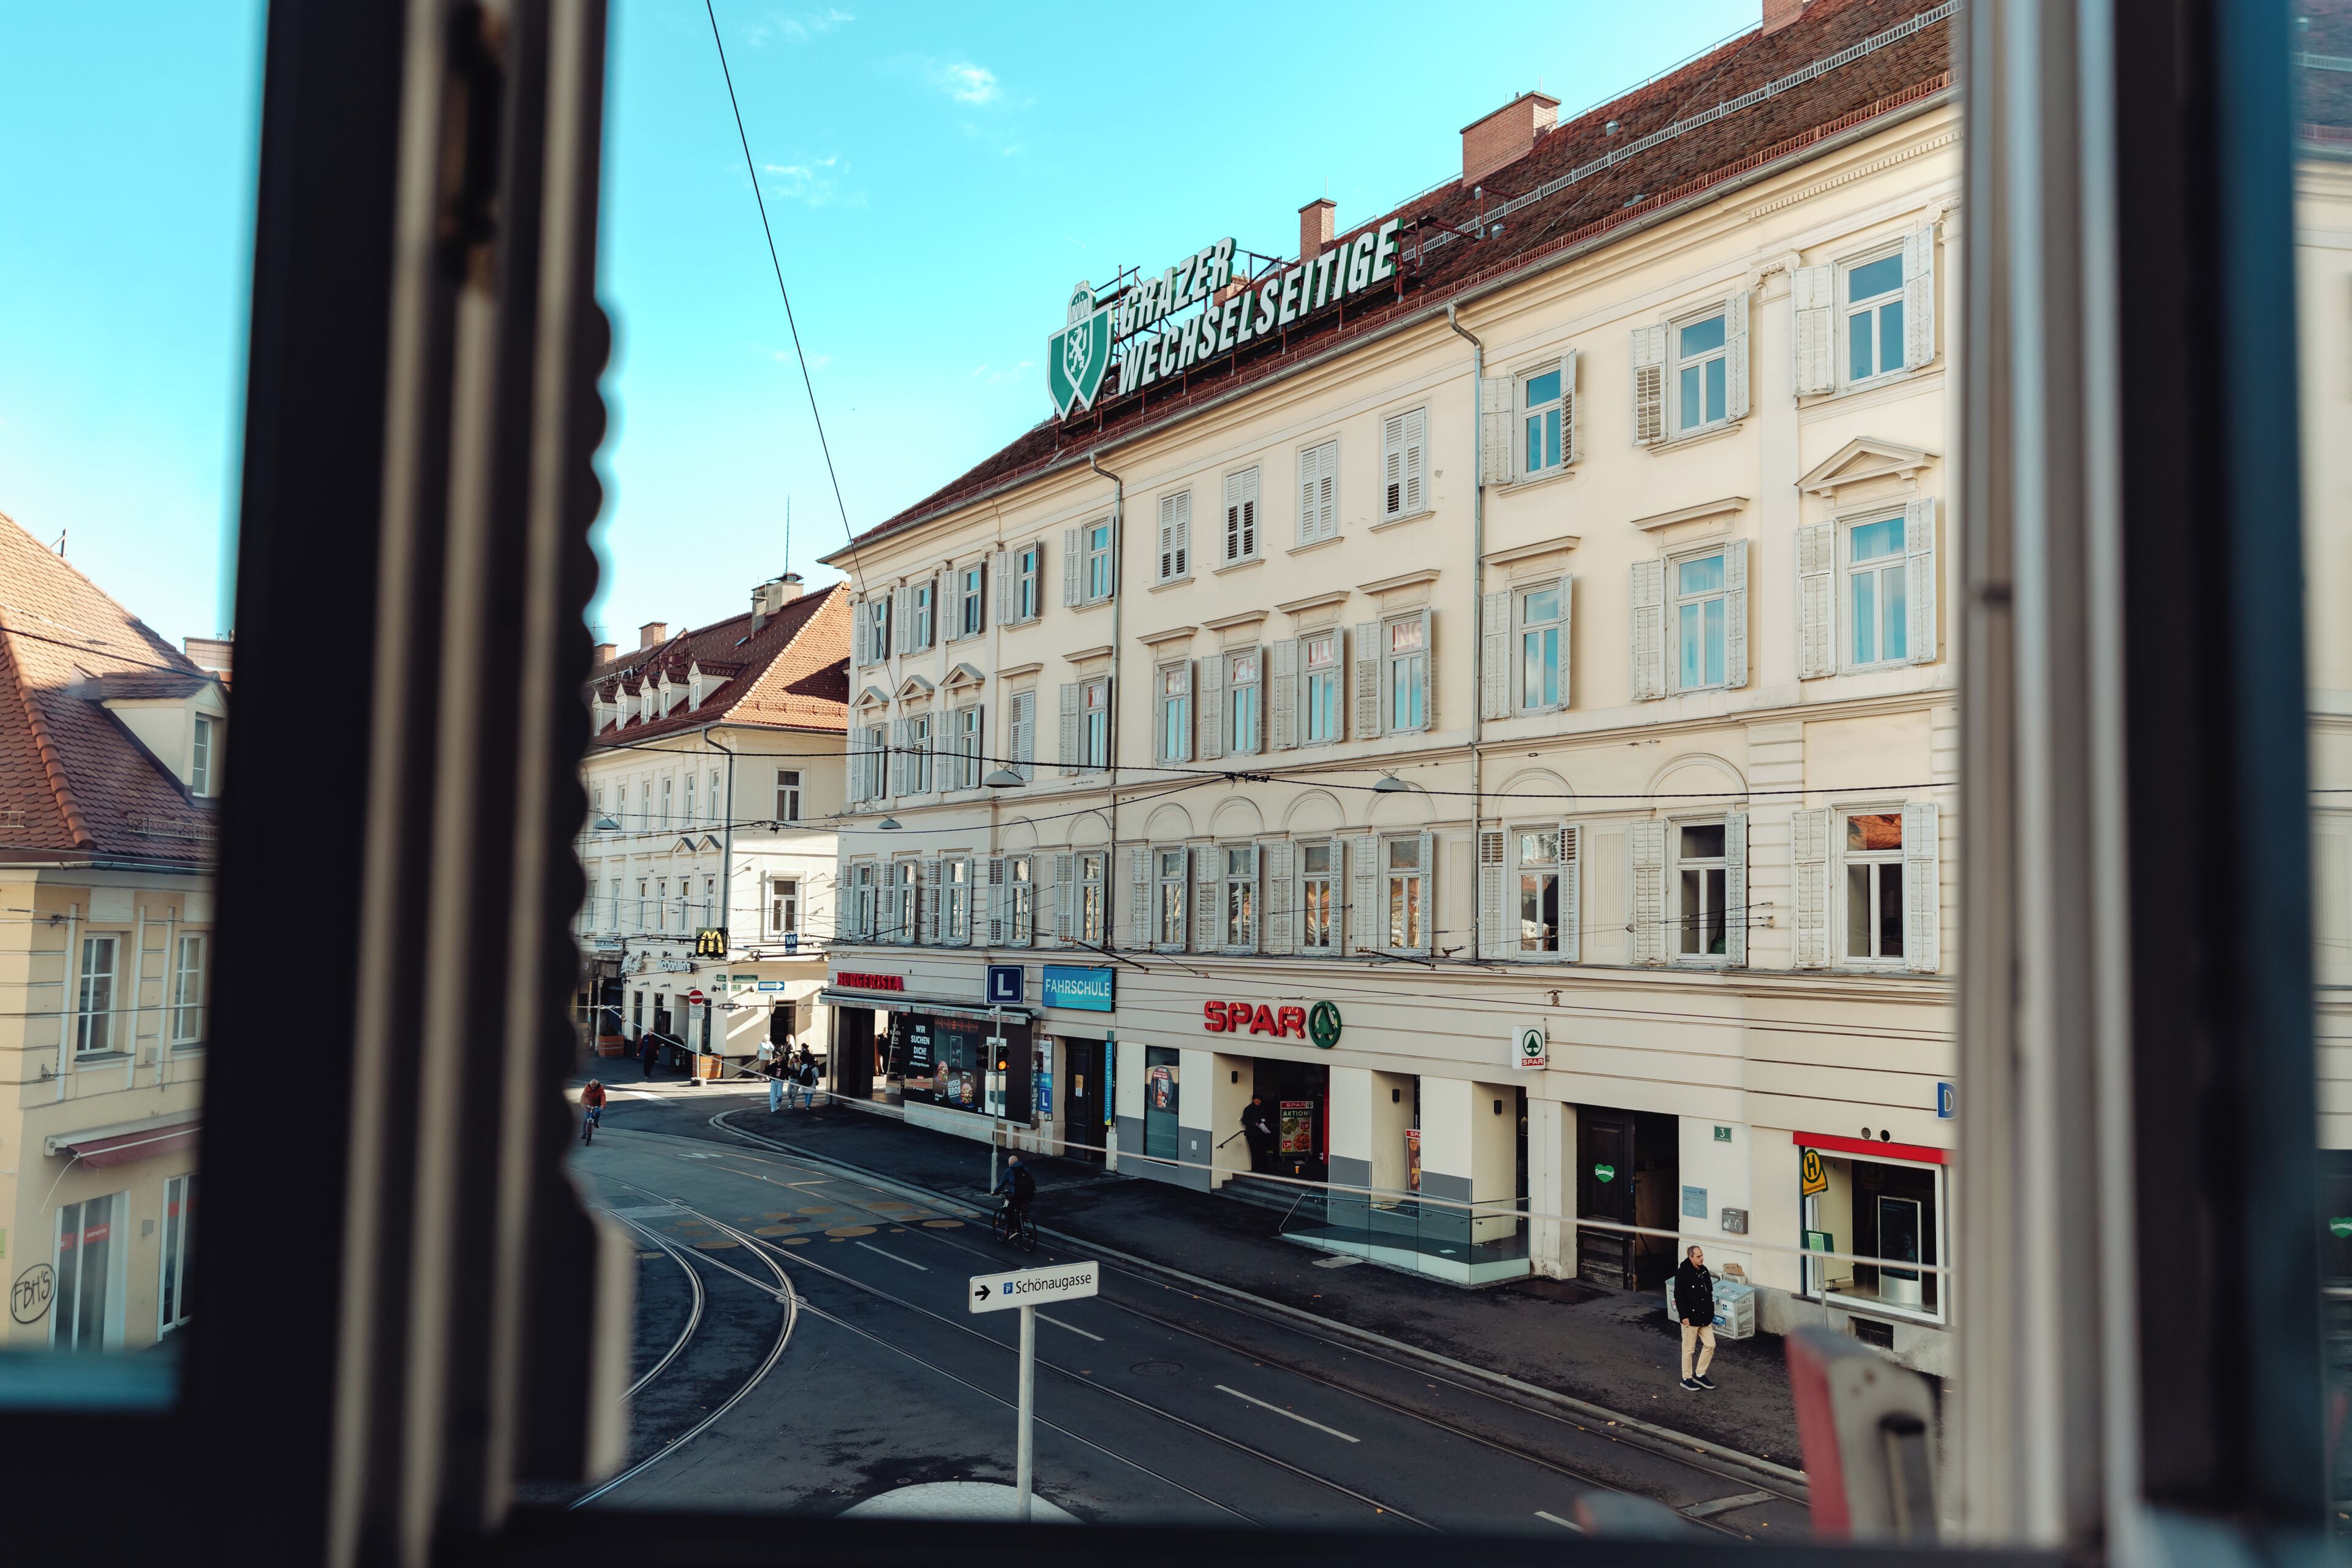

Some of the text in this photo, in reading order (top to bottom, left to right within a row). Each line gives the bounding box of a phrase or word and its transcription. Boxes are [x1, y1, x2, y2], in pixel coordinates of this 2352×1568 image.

[1120, 236, 1237, 339] GRAZER
[1118, 217, 1404, 396] WECHSELSEITIGE
[657, 960, 692, 974] McDonald's
[837, 972, 904, 991] BURGERISTA
[998, 974, 1013, 996] L
[1046, 979, 1110, 997] FAHRSCHULE
[916, 1025, 925, 1033] WIR
[1204, 1001, 1306, 1039] SPAR
[911, 1035, 930, 1045] SUCHEN
[913, 1046, 927, 1055] DICH!
[948, 1086, 960, 1095] BROS
[1720, 1128, 1725, 1137] 3
[1806, 1154, 1817, 1177] H
[1016, 1274, 1091, 1294] Schönaugasse
